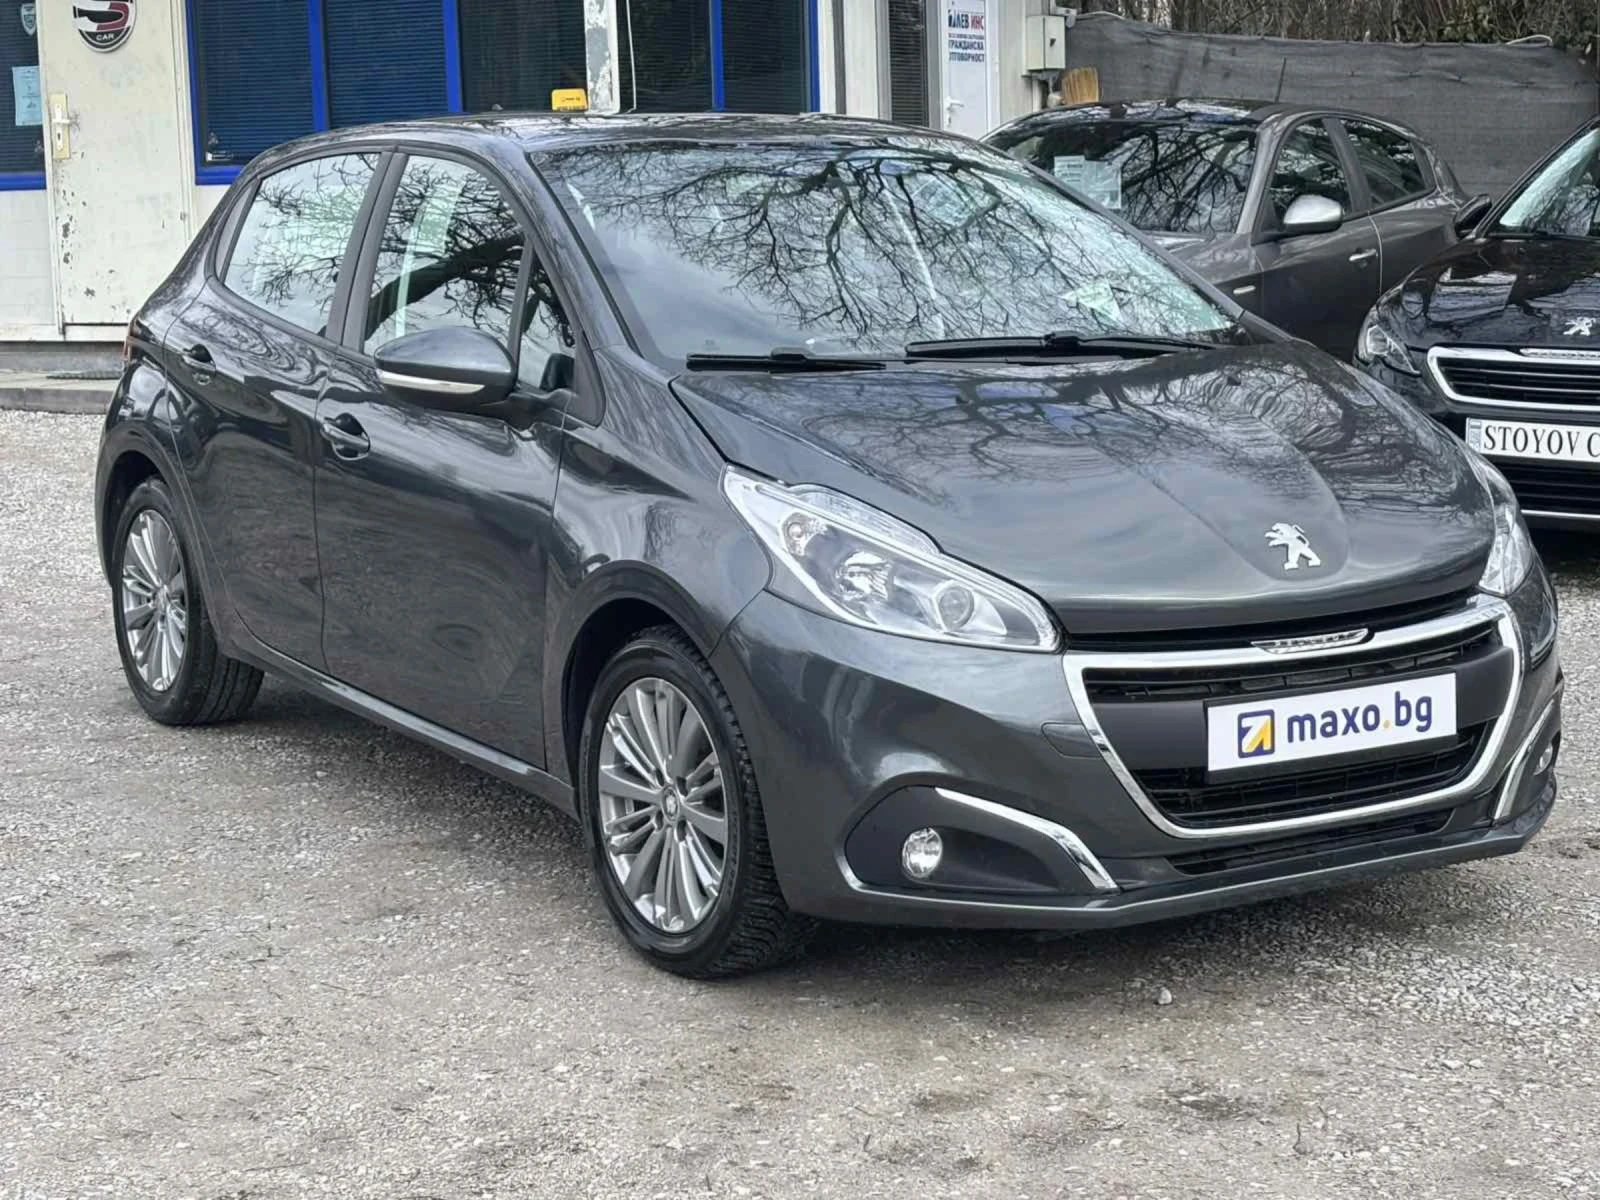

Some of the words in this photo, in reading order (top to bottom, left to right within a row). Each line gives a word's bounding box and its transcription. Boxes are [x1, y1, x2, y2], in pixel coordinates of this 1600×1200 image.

[96, 33, 115, 41] CAR
[1484, 425, 1580, 457] STOYOV
[1287, 691, 1432, 743] maxo.bg
